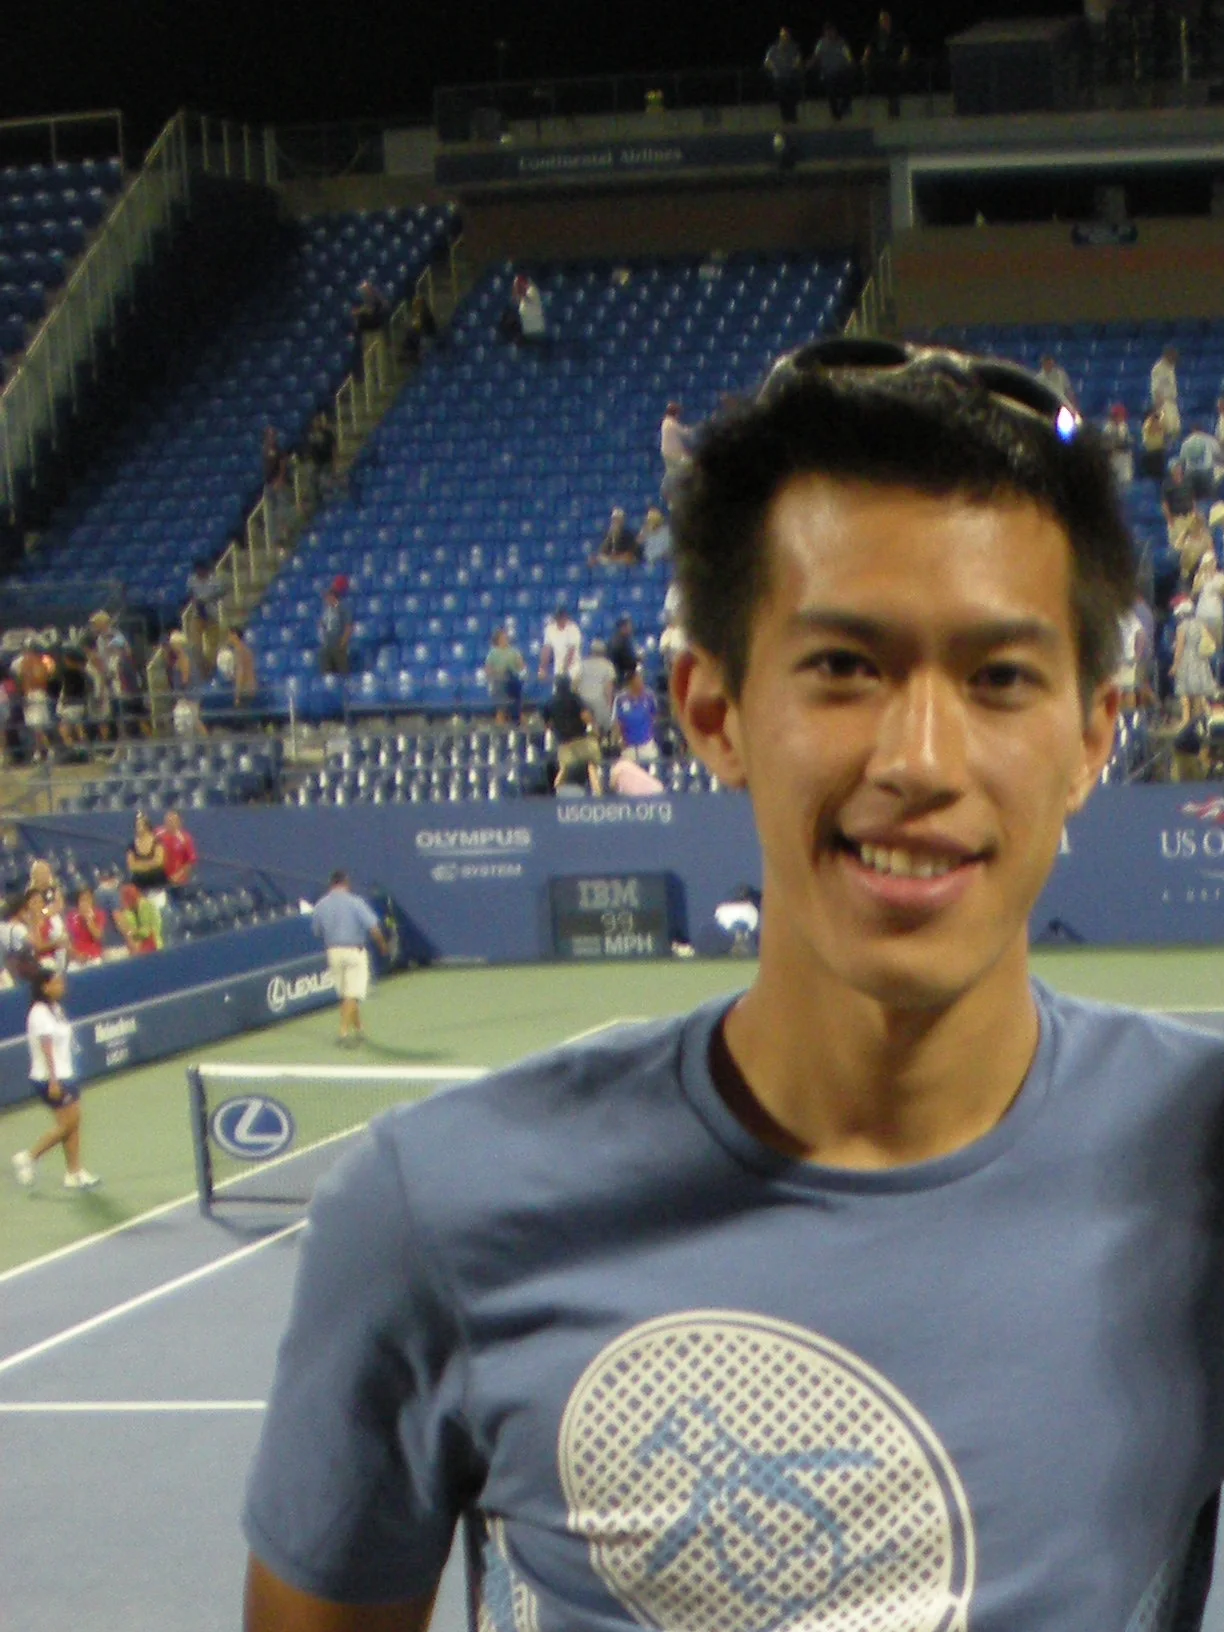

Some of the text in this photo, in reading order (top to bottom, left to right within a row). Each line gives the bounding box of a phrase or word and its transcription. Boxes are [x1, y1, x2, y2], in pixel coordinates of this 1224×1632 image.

[556, 801, 673, 824] usopen.org
[415, 827, 532, 850] OLYMPUS
[1161, 828, 1197, 858] US
[578, 878, 640, 910] IBM
[603, 934, 654, 955] MPH
